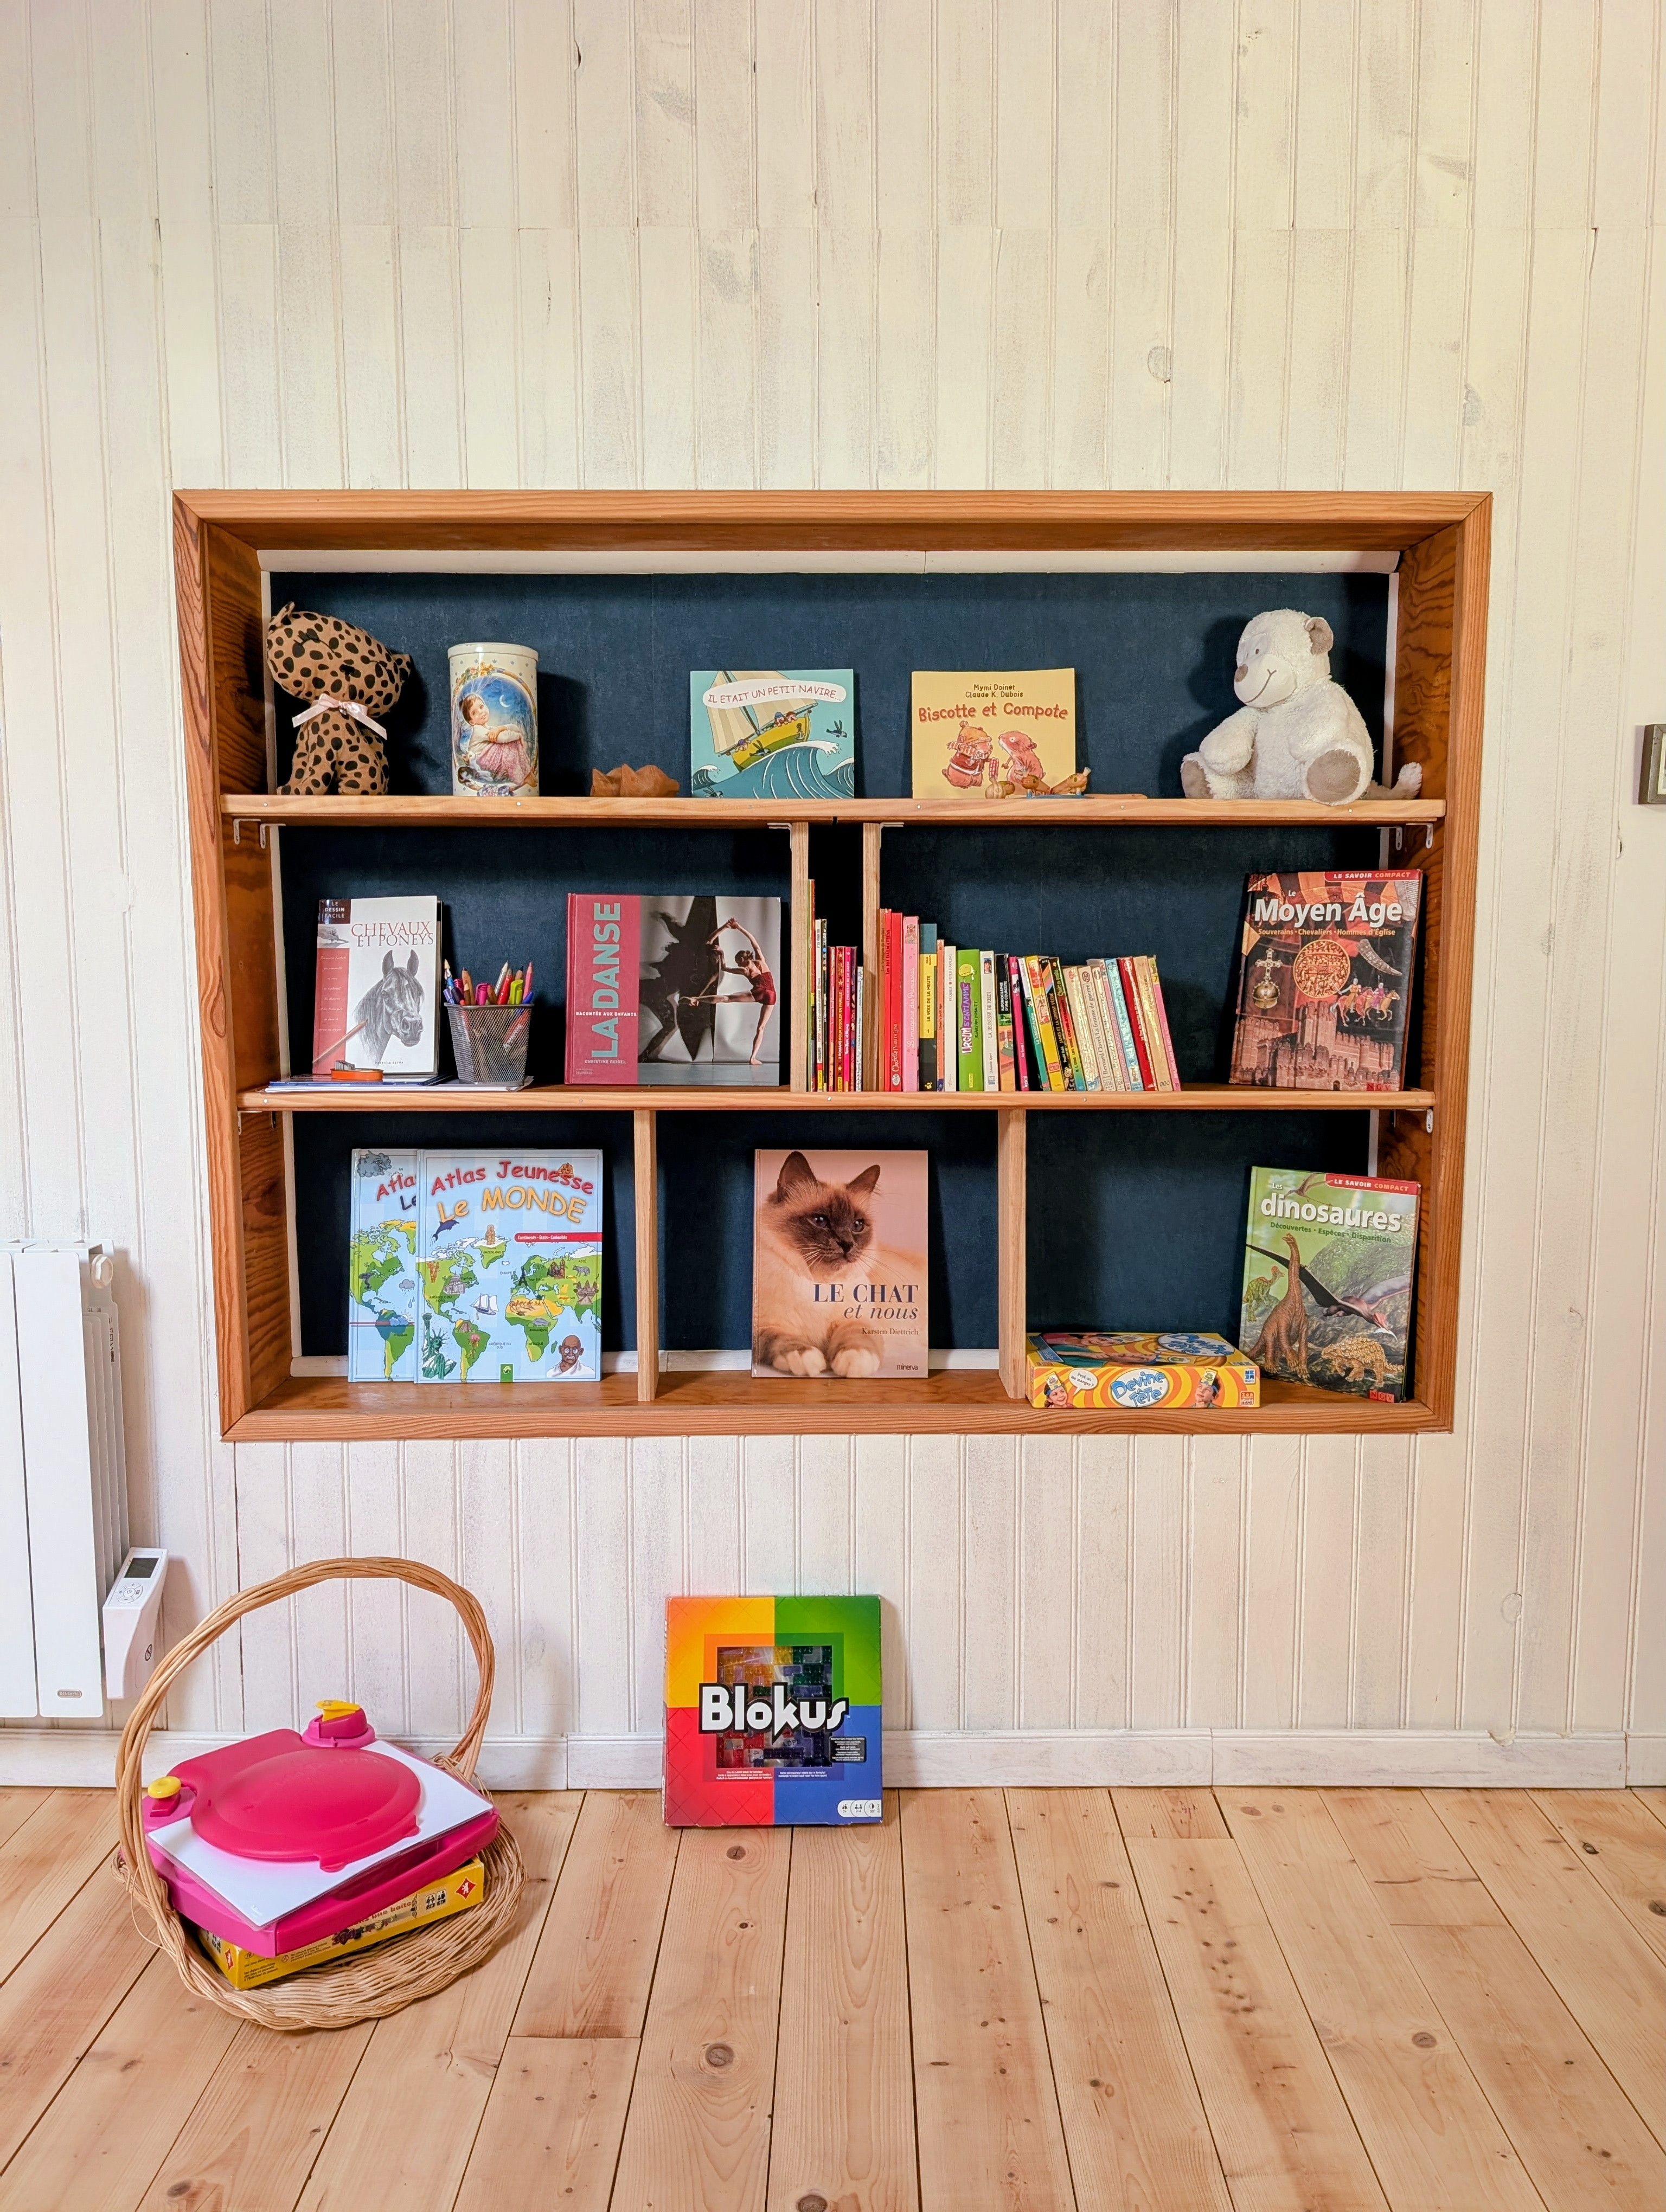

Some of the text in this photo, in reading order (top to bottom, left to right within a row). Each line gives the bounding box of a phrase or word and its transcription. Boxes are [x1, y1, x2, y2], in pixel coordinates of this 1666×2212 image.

[707, 694, 717, 703] IL
[720, 692, 749, 703] ETAIT
[751, 689, 766, 698] UN
[768, 685, 797, 696] PETIT
[918, 702, 1069, 723] Biscotte et Compote
[1254, 892, 1402, 928] Moyen Âge
[351, 921, 431, 937] CHEVAUX
[357, 933, 434, 947] ET PONEYS
[591, 902, 620, 1058] LA DANSE
[376, 1174, 416, 1201] Atla
[431, 1160, 594, 1196] Atlas Jeunesse
[1345, 1180, 1372, 1188] SAVOIR
[1374, 1182, 1409, 1192] COMPACT
[437, 1186, 587, 1224] Le MONDE
[1260, 1193, 1402, 1232] dinosaures
[1270, 1221, 1392, 1244] Découvertes Espèces Disparition
[812, 1284, 919, 1303] LE CHAT
[844, 1304, 918, 1320] et nous
[1111, 1371, 1165, 1399] Devine
[1370, 1391, 1394, 1403] NGV
[700, 1683, 848, 1741] Blokus
